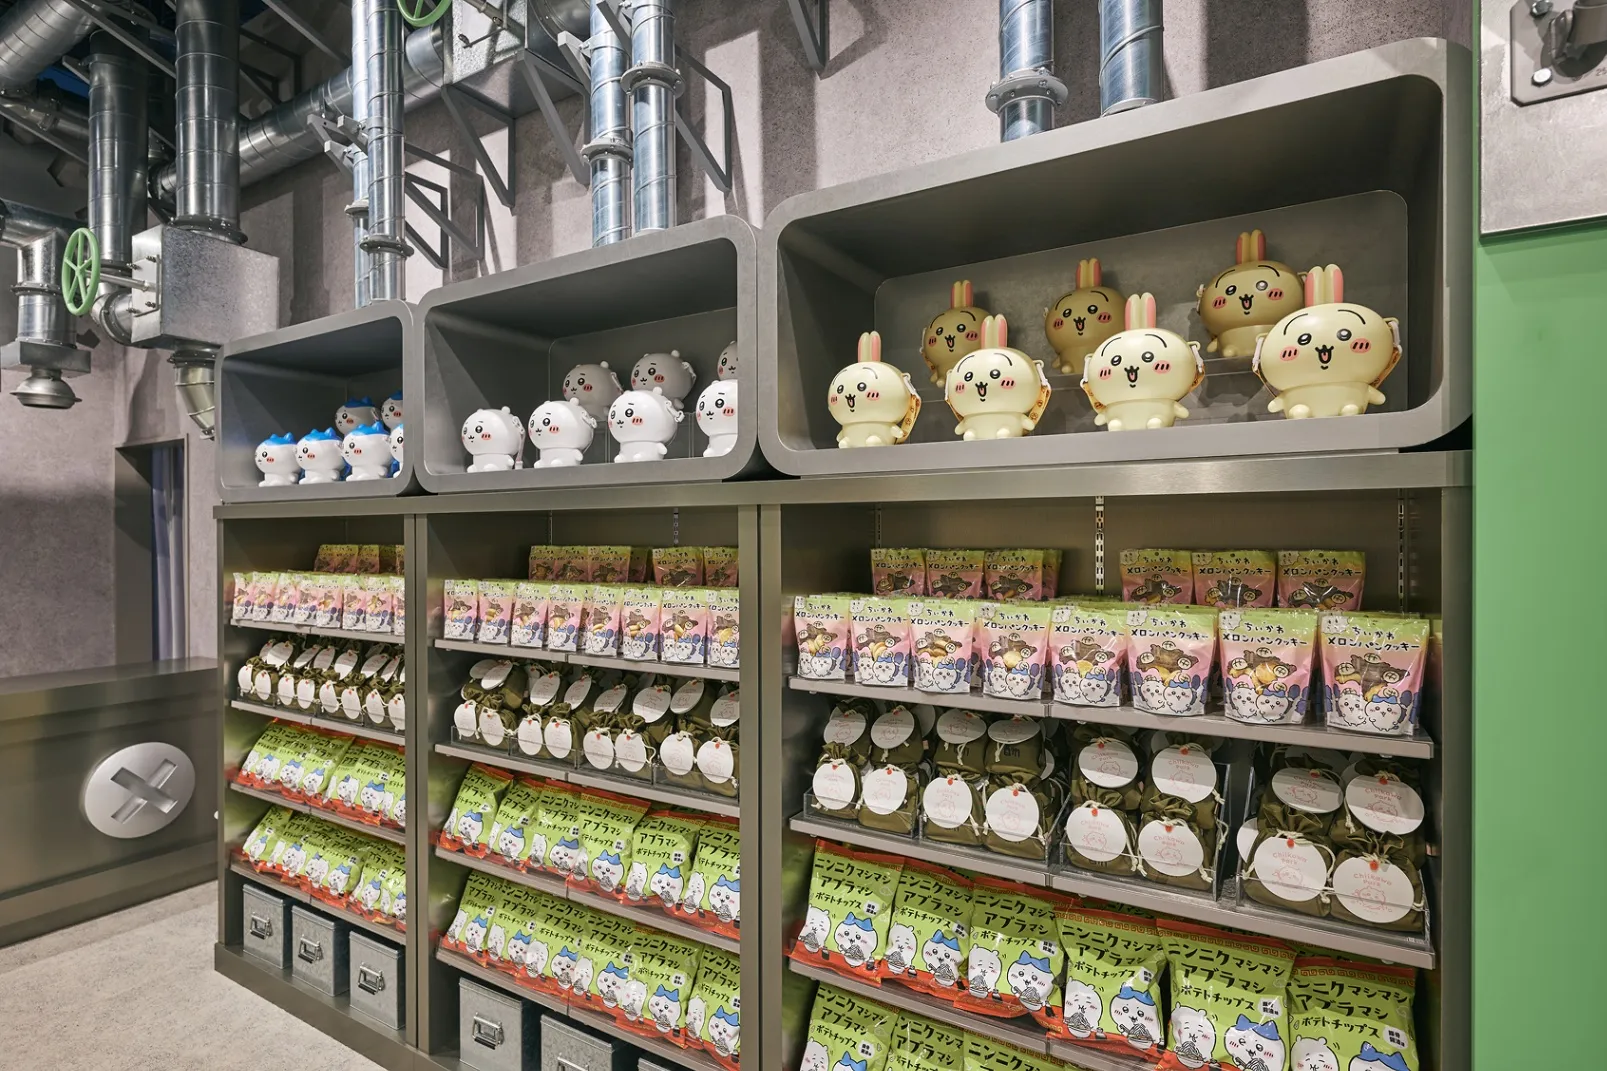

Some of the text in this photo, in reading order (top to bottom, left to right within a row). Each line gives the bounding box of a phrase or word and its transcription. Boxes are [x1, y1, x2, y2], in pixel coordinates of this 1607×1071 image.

[1143, 556, 1172, 564] ちいかわ
[1217, 557, 1250, 565] ちいかわ
[1303, 557, 1339, 566] ちいかわ
[1126, 567, 1188, 575] メロンパンクッキー
[1199, 567, 1272, 575] メロンパンクッキー
[1283, 568, 1362, 577] メロンパンクッキー
[795, 611, 845, 620] メロンパンクッキー
[808, 603, 832, 611] ちいかわ
[867, 605, 893, 614] ちいかわ
[926, 608, 954, 618] ちいかわ
[852, 615, 907, 624] メロンパンクッキー
[910, 618, 970, 628] メロンパンクッキー
[983, 621, 1046, 631] メロンパンクッキー
[999, 612, 1030, 622] ちいかわ
[1074, 616, 1106, 627] ちいかわ
[1151, 616, 1187, 628] ちいかわ
[1054, 624, 1125, 638] メロンパンクッキー
[1131, 627, 1209, 641] メロンパンクッキー
[1244, 621, 1285, 634] ちいかわ
[1352, 625, 1395, 641] ちいかわ
[1222, 633, 1308, 646] メロンパンクッキー
[1327, 636, 1420, 652] メロンパンクッキー
[541, 795, 580, 811] ニンニクマシ
[580, 803, 635, 825] ニンニクマシマシ
[583, 818, 623, 837] アブラマシ
[699, 828, 740, 846] ニンニクマ
[640, 832, 679, 848] アブラマシ
[636, 847, 671, 861] ポテトチップス
[814, 858, 891, 885] ニンニクマシマシ
[1353, 873, 1393, 887] Chiikawa
[820, 875, 873, 897] アブラマシ
[898, 874, 973, 904] ニンニクマシマ
[501, 898, 536, 917] アブラマシ
[541, 899, 587, 920] ニンニクマシ
[815, 891, 862, 910] ポテトチップス
[904, 891, 964, 917] アブラマシ
[975, 895, 1056, 921] ニンニクマシマ
[543, 913, 584, 934] アブラマシ
[588, 915, 634, 935] ニンニクマシ
[900, 907, 952, 928] ポテトチップス
[984, 911, 1049, 936] アブラマシ
[539, 927, 574, 944] ポテトチップス
[589, 929, 632, 949] アブラマシ
[584, 943, 620, 959] ポテトチップス
[634, 936, 694, 957] ニンニクマシマシ
[1076, 942, 1146, 967] アブラマシ
[640, 951, 680, 970] アブラマシ
[1168, 943, 1286, 978] ニンニクマシマシ
[703, 966, 740, 991] アブラマシ
[1074, 961, 1136, 980] ポテトチップス
[1181, 962, 1266, 994] アブラマシ
[816, 986, 888, 1026] ニンニクマシマシ
[1181, 985, 1256, 1012] ポテトチップス
[1296, 994, 1389, 1020] アブラマシ
[820, 1006, 867, 1036] アブラマシ
[1301, 1017, 1381, 1039] ポテトチップス
[816, 1024, 857, 1050] ポテトチップス
[895, 1015, 964, 1050] ンニクマシマ
[896, 1034, 955, 1066] アブラマシ
[968, 1041, 1040, 1071] ニンニクマ
